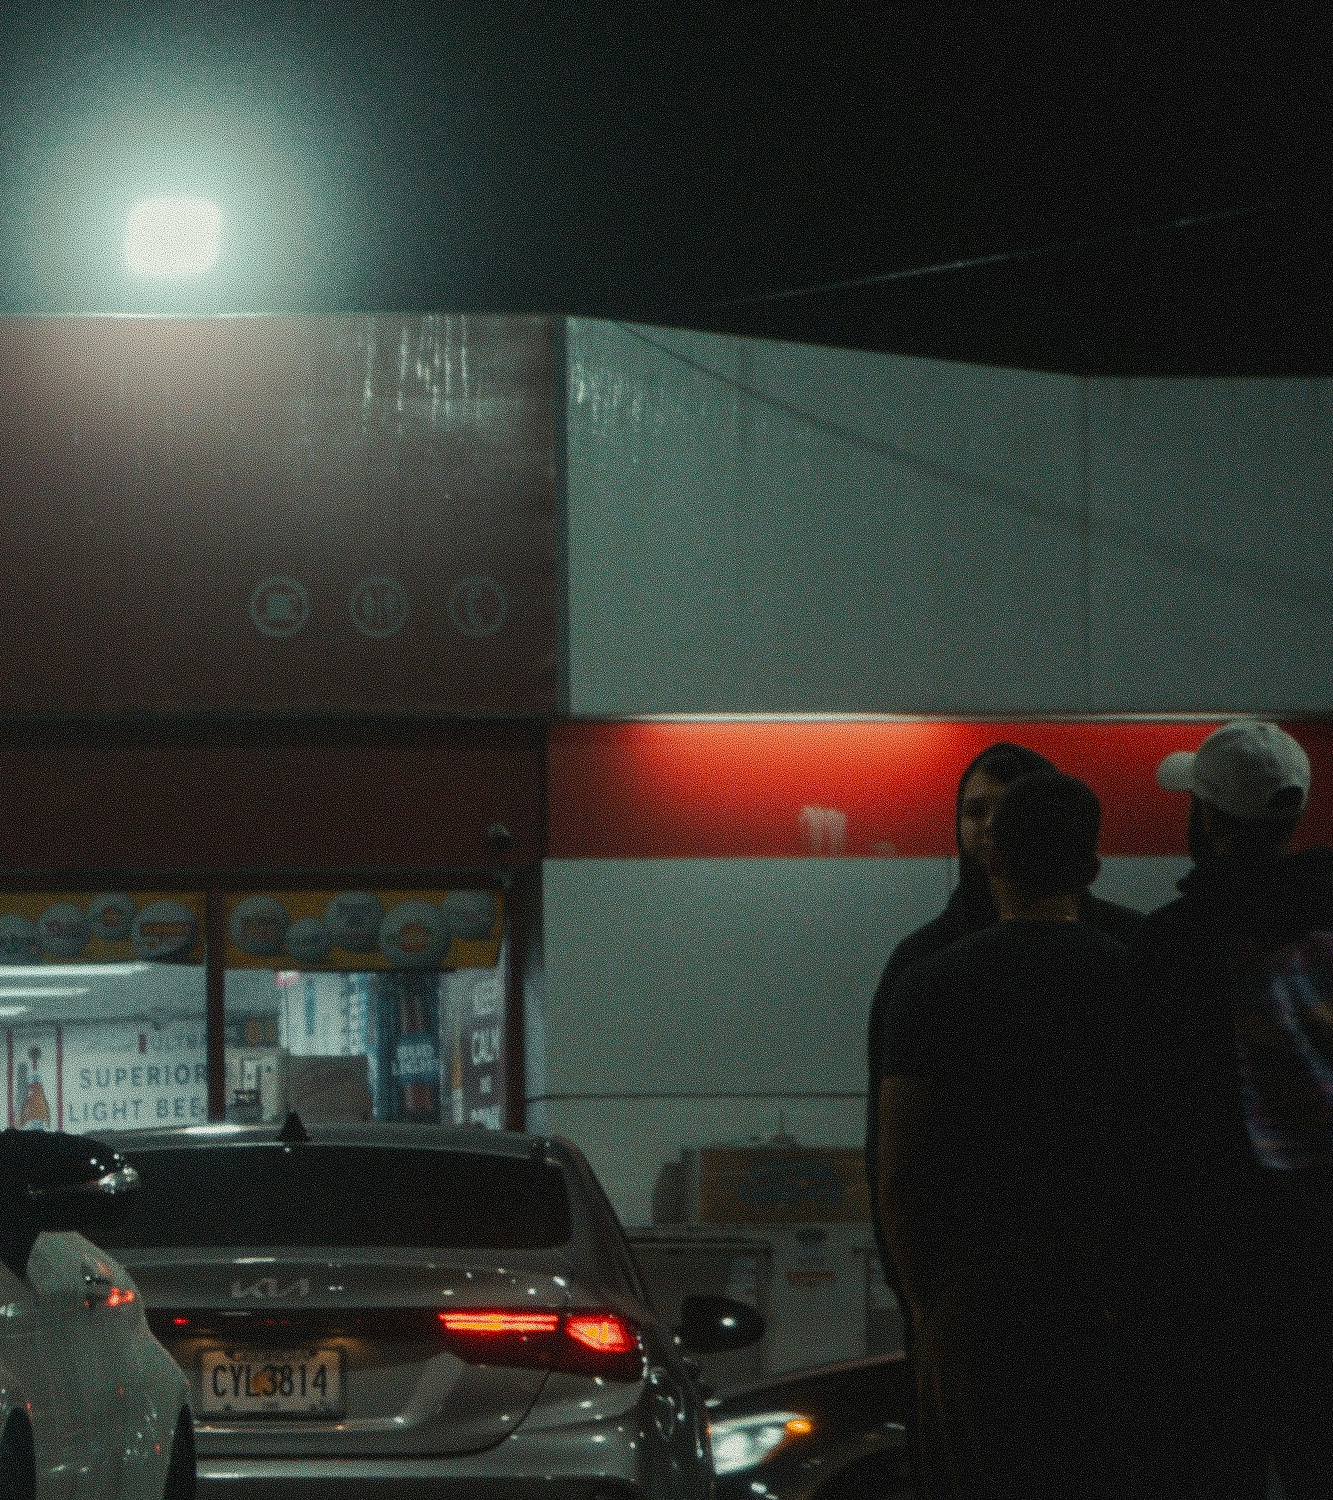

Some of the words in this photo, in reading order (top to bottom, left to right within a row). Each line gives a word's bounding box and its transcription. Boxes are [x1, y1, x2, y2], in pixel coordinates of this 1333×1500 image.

[79, 1063, 207, 1090] SUPERIOR
[67, 1098, 143, 1124] LIGHT
[156, 1096, 206, 1119] BEE
[211, 1364, 327, 1398] CYL3814
